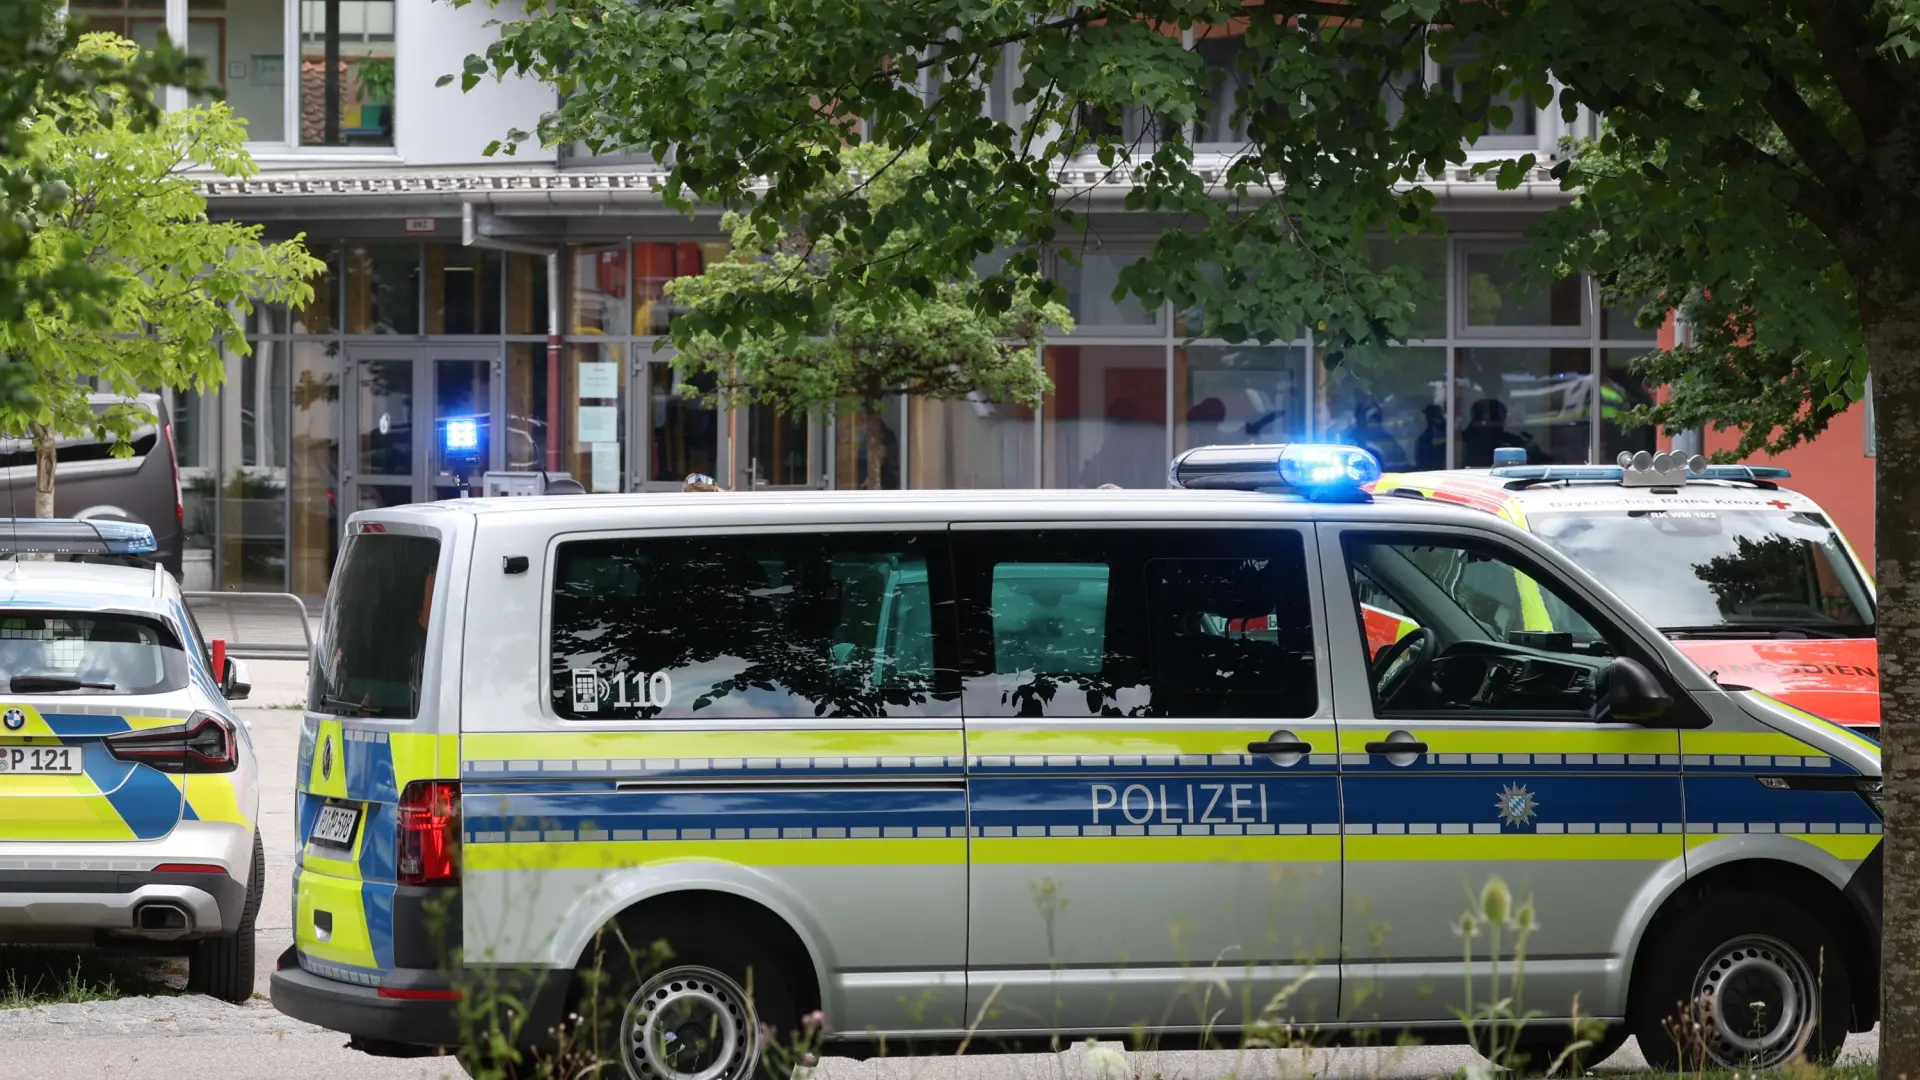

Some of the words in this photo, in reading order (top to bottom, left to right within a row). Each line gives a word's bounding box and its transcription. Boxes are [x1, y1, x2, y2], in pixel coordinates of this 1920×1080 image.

[1714, 498, 1762, 506] Kreuz
[1650, 511, 1668, 519] RK
[1671, 511, 1692, 519] WM
[612, 671, 672, 708] 110
[10, 749, 24, 770] P
[30, 749, 72, 771] 121
[1091, 783, 1268, 824] POLIZEI
[334, 812, 353, 839] 598
